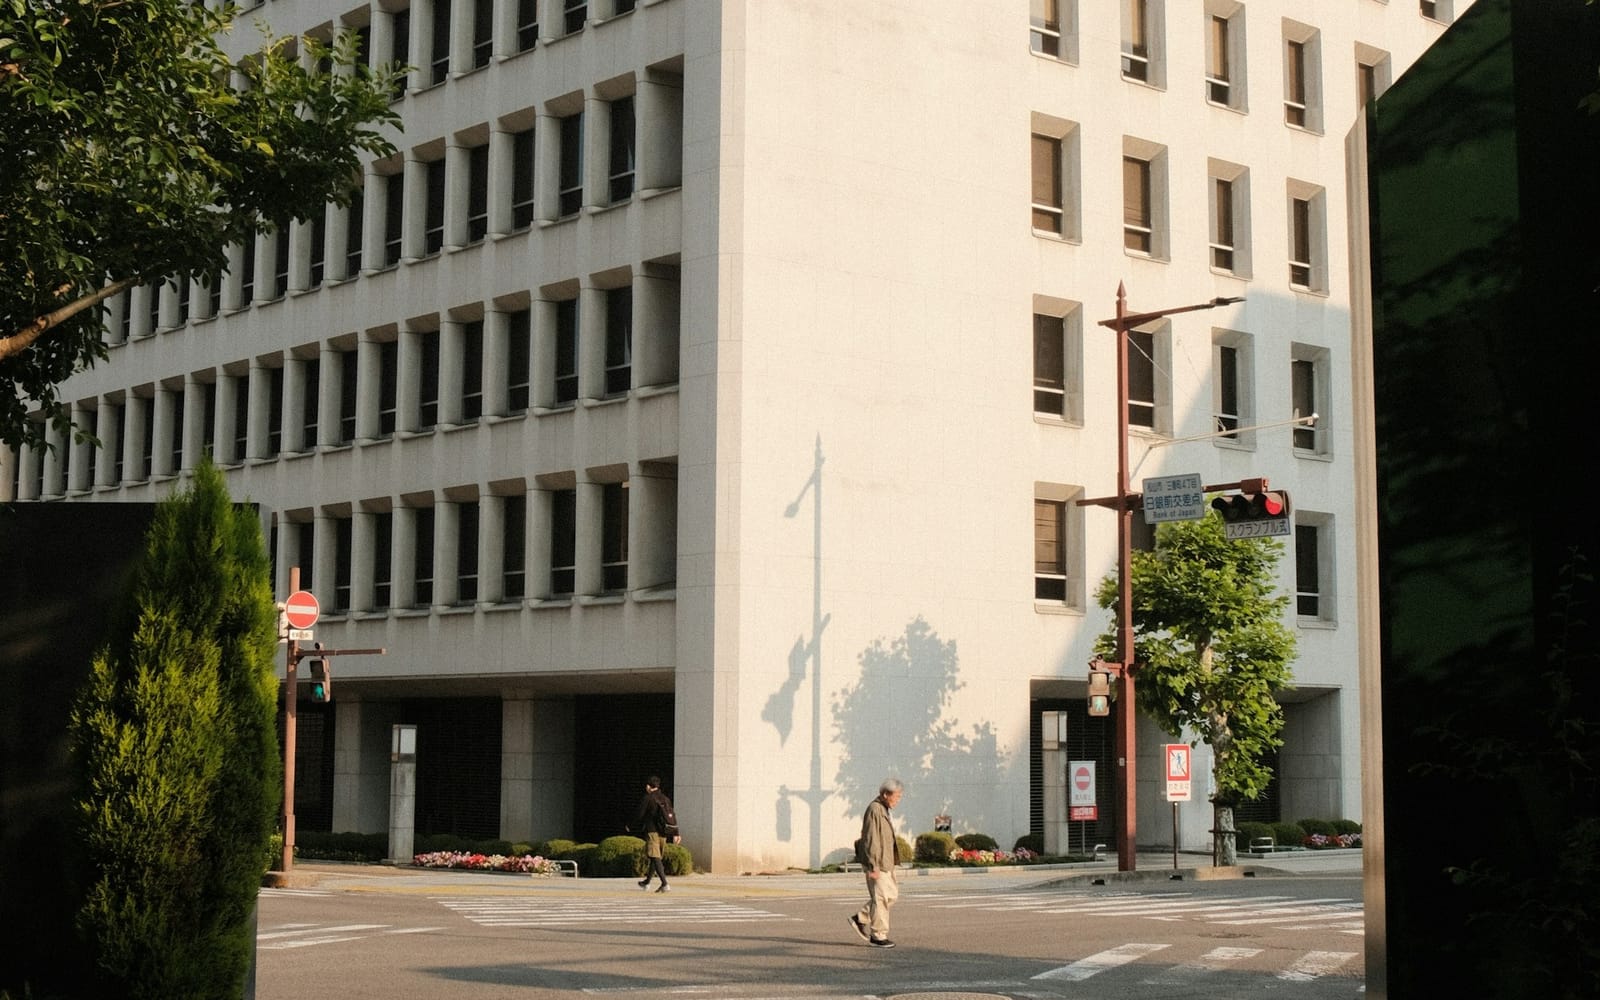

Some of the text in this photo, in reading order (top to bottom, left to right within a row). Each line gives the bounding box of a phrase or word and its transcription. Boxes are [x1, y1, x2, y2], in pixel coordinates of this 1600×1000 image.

[1146, 493, 1202, 510] 日銀前交差点
